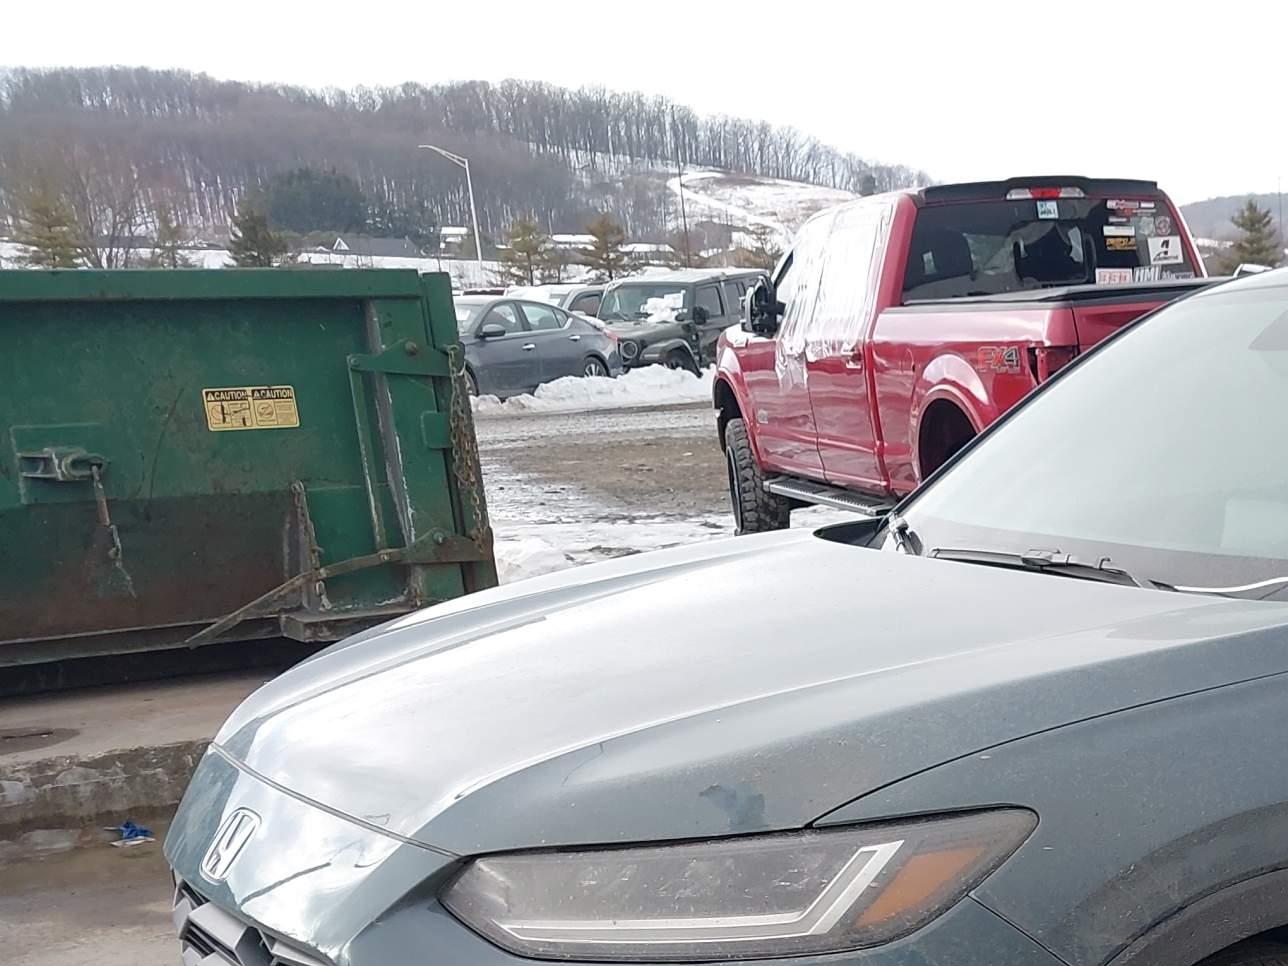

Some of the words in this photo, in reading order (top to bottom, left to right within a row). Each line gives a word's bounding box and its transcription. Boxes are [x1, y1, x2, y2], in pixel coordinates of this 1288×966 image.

[977, 346, 1020, 370] FX4
[214, 391, 248, 400] CAUTION
[261, 389, 293, 399] CAUTION
